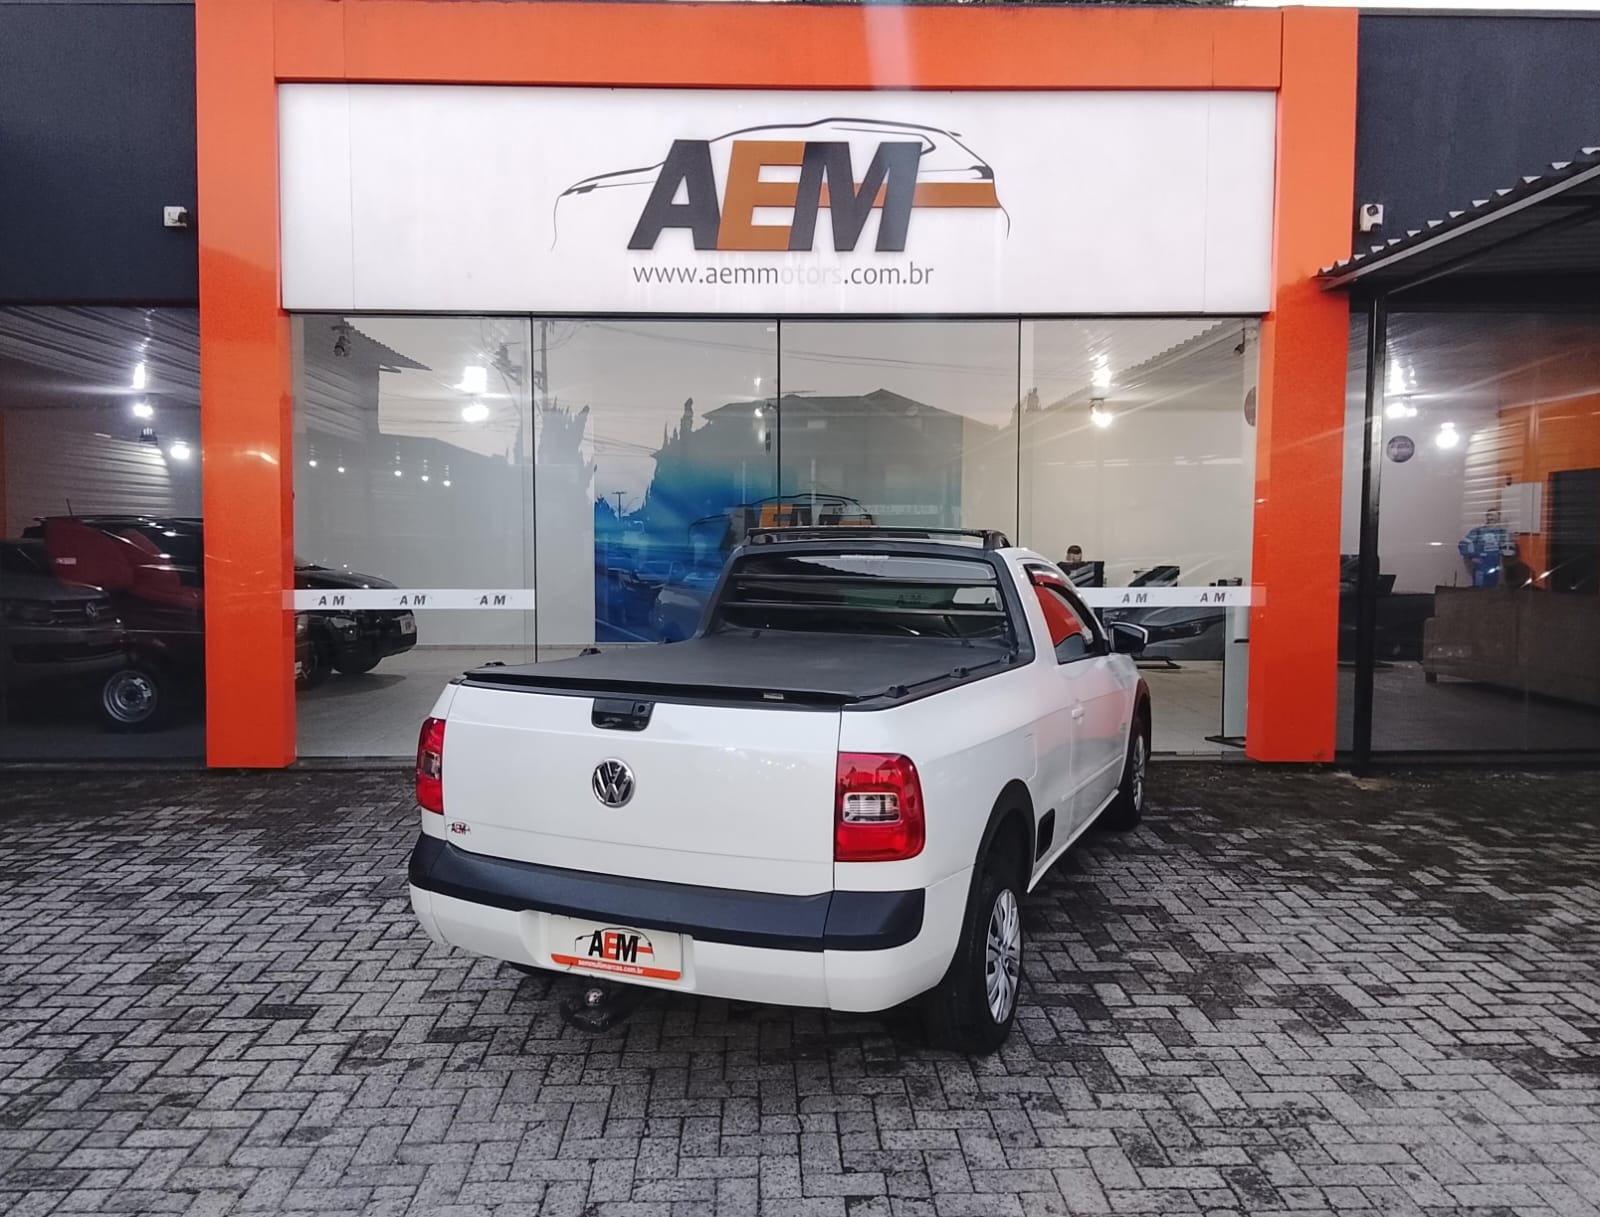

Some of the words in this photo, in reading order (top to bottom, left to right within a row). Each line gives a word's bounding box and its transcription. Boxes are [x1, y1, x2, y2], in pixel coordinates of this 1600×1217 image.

[626, 139, 923, 251] AEM
[633, 261, 934, 285] www.aemmotors.com.br
[588, 930, 639, 963] AEM
